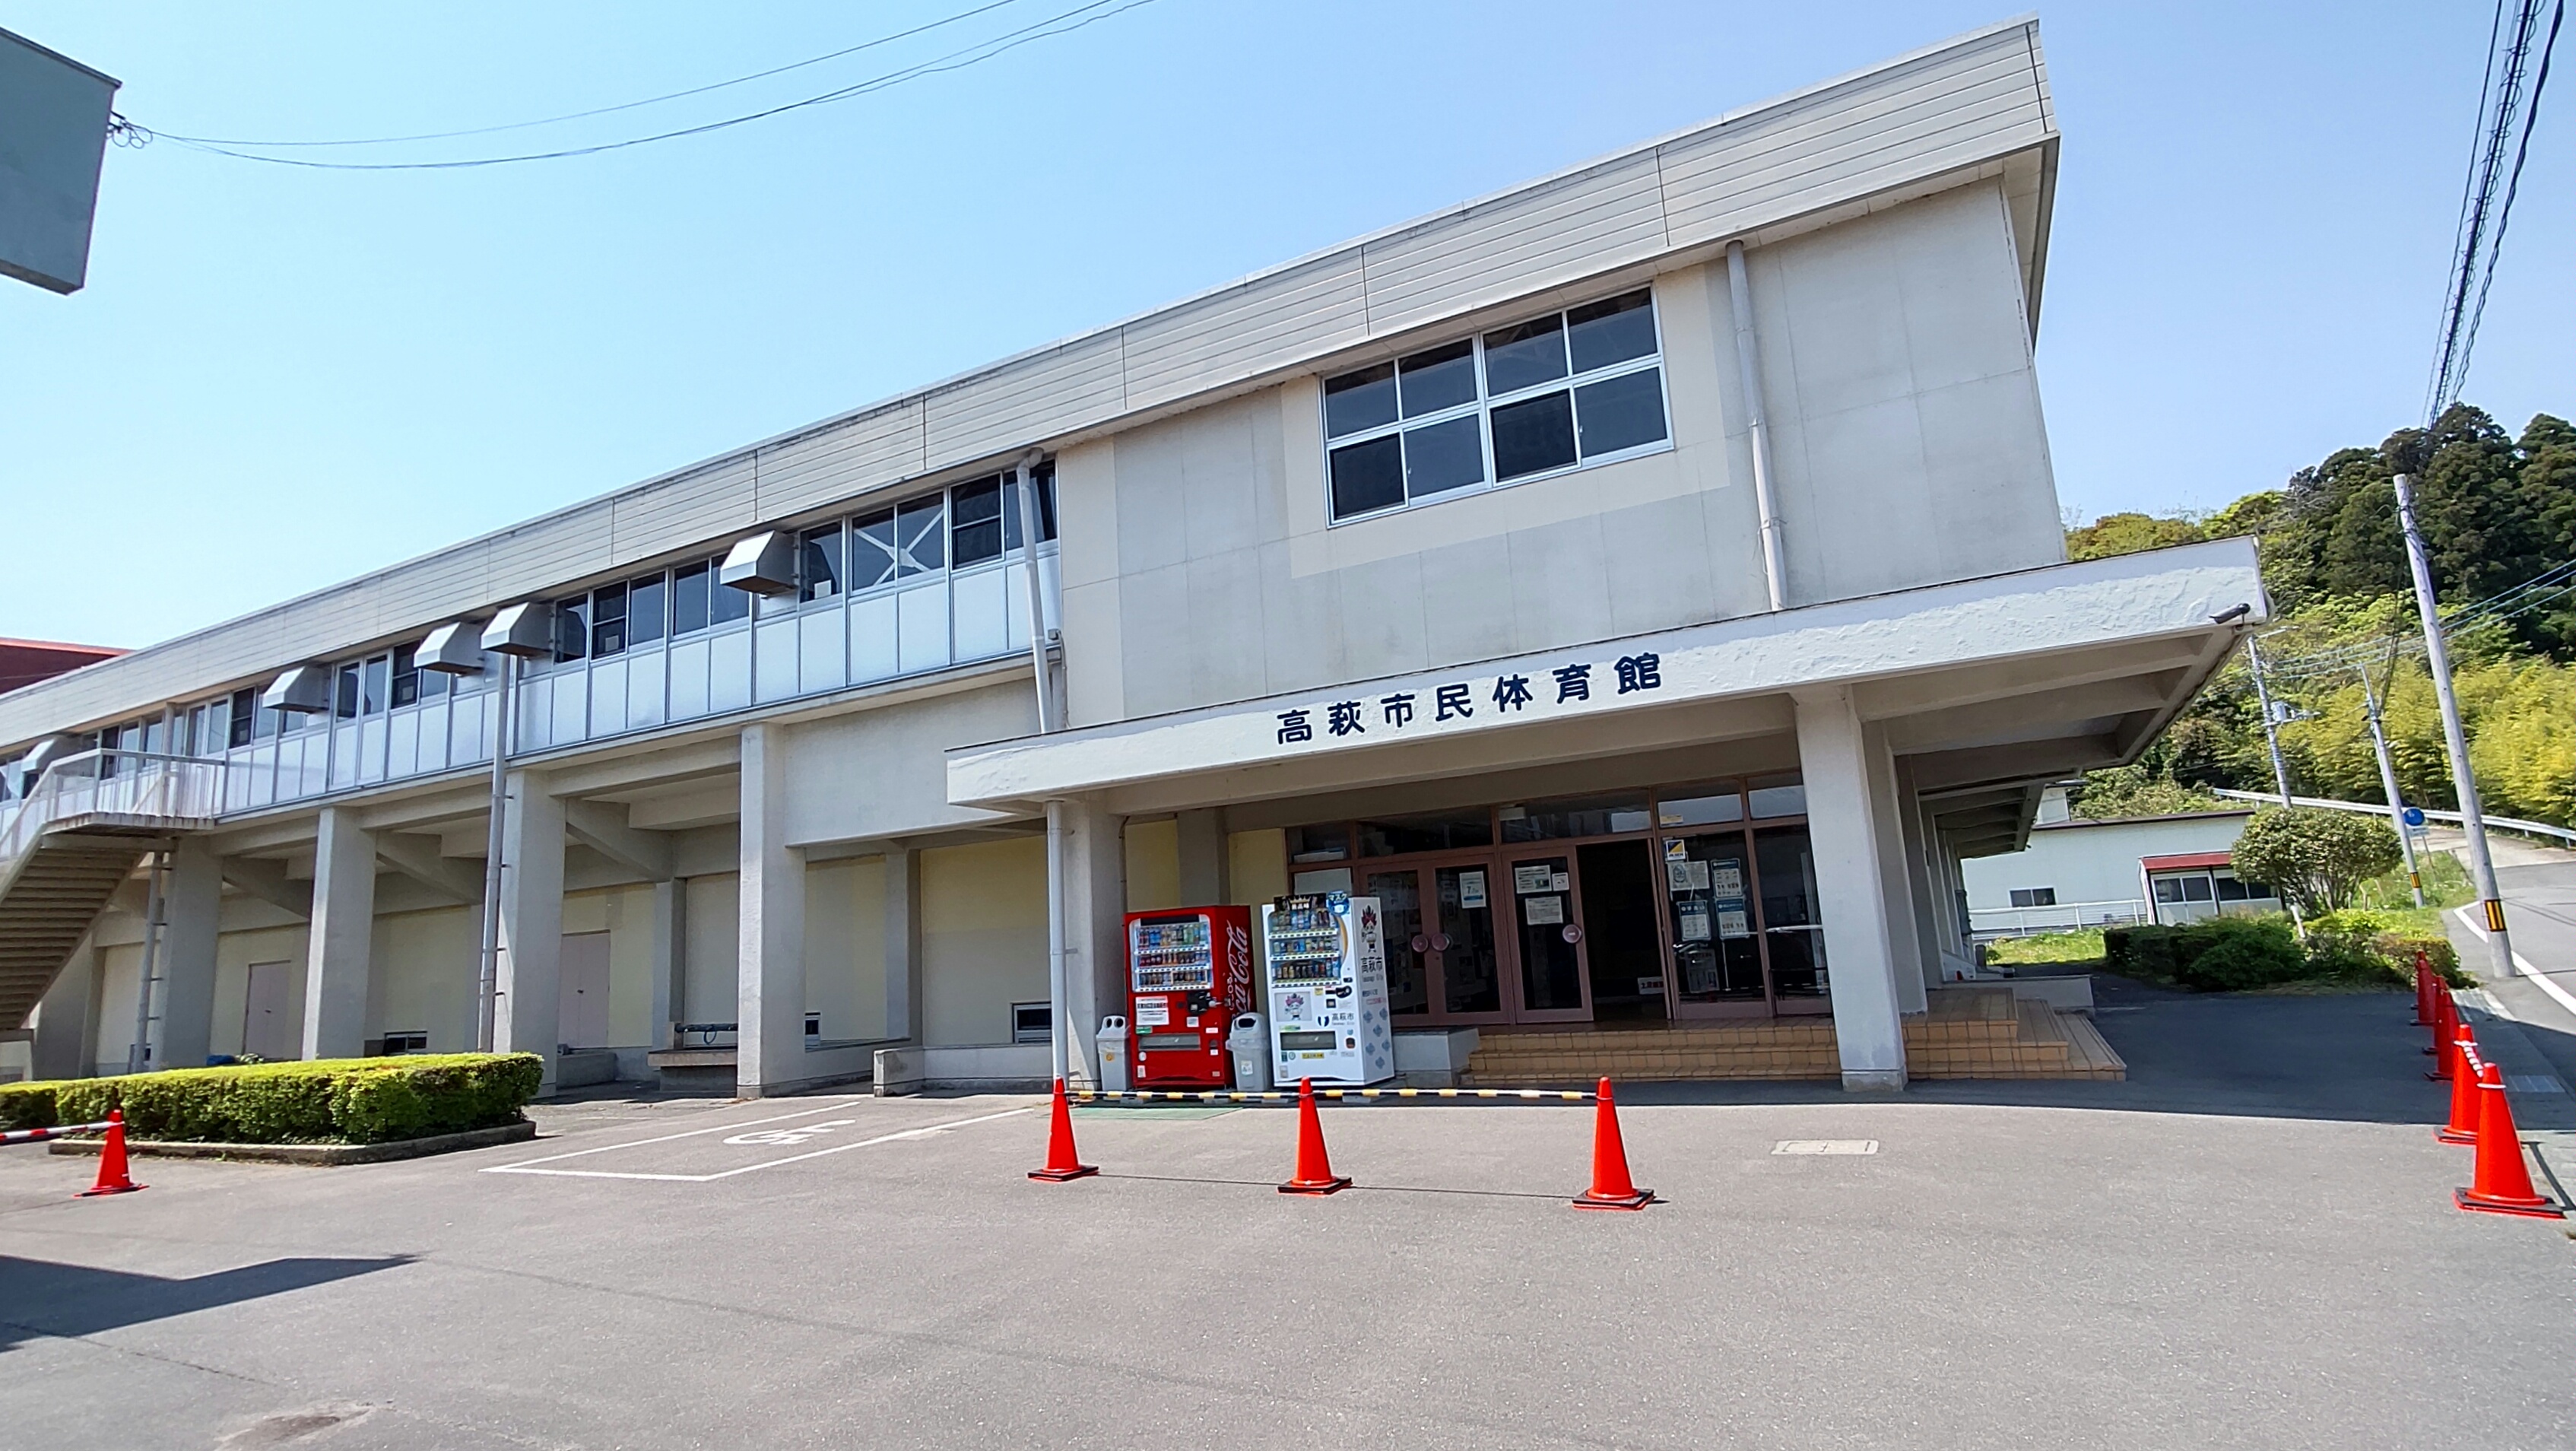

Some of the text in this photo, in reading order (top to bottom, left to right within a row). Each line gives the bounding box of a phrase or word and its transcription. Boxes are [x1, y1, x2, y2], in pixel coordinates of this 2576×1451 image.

[1277, 652, 1662, 745] 高萩市民体育館
[1328, 893, 1347, 901] マスク
[1226, 919, 1251, 1018] ca-Cola
[1360, 956, 1382, 973] 高萩市
[1332, 1012, 1354, 1021] 高萩市
